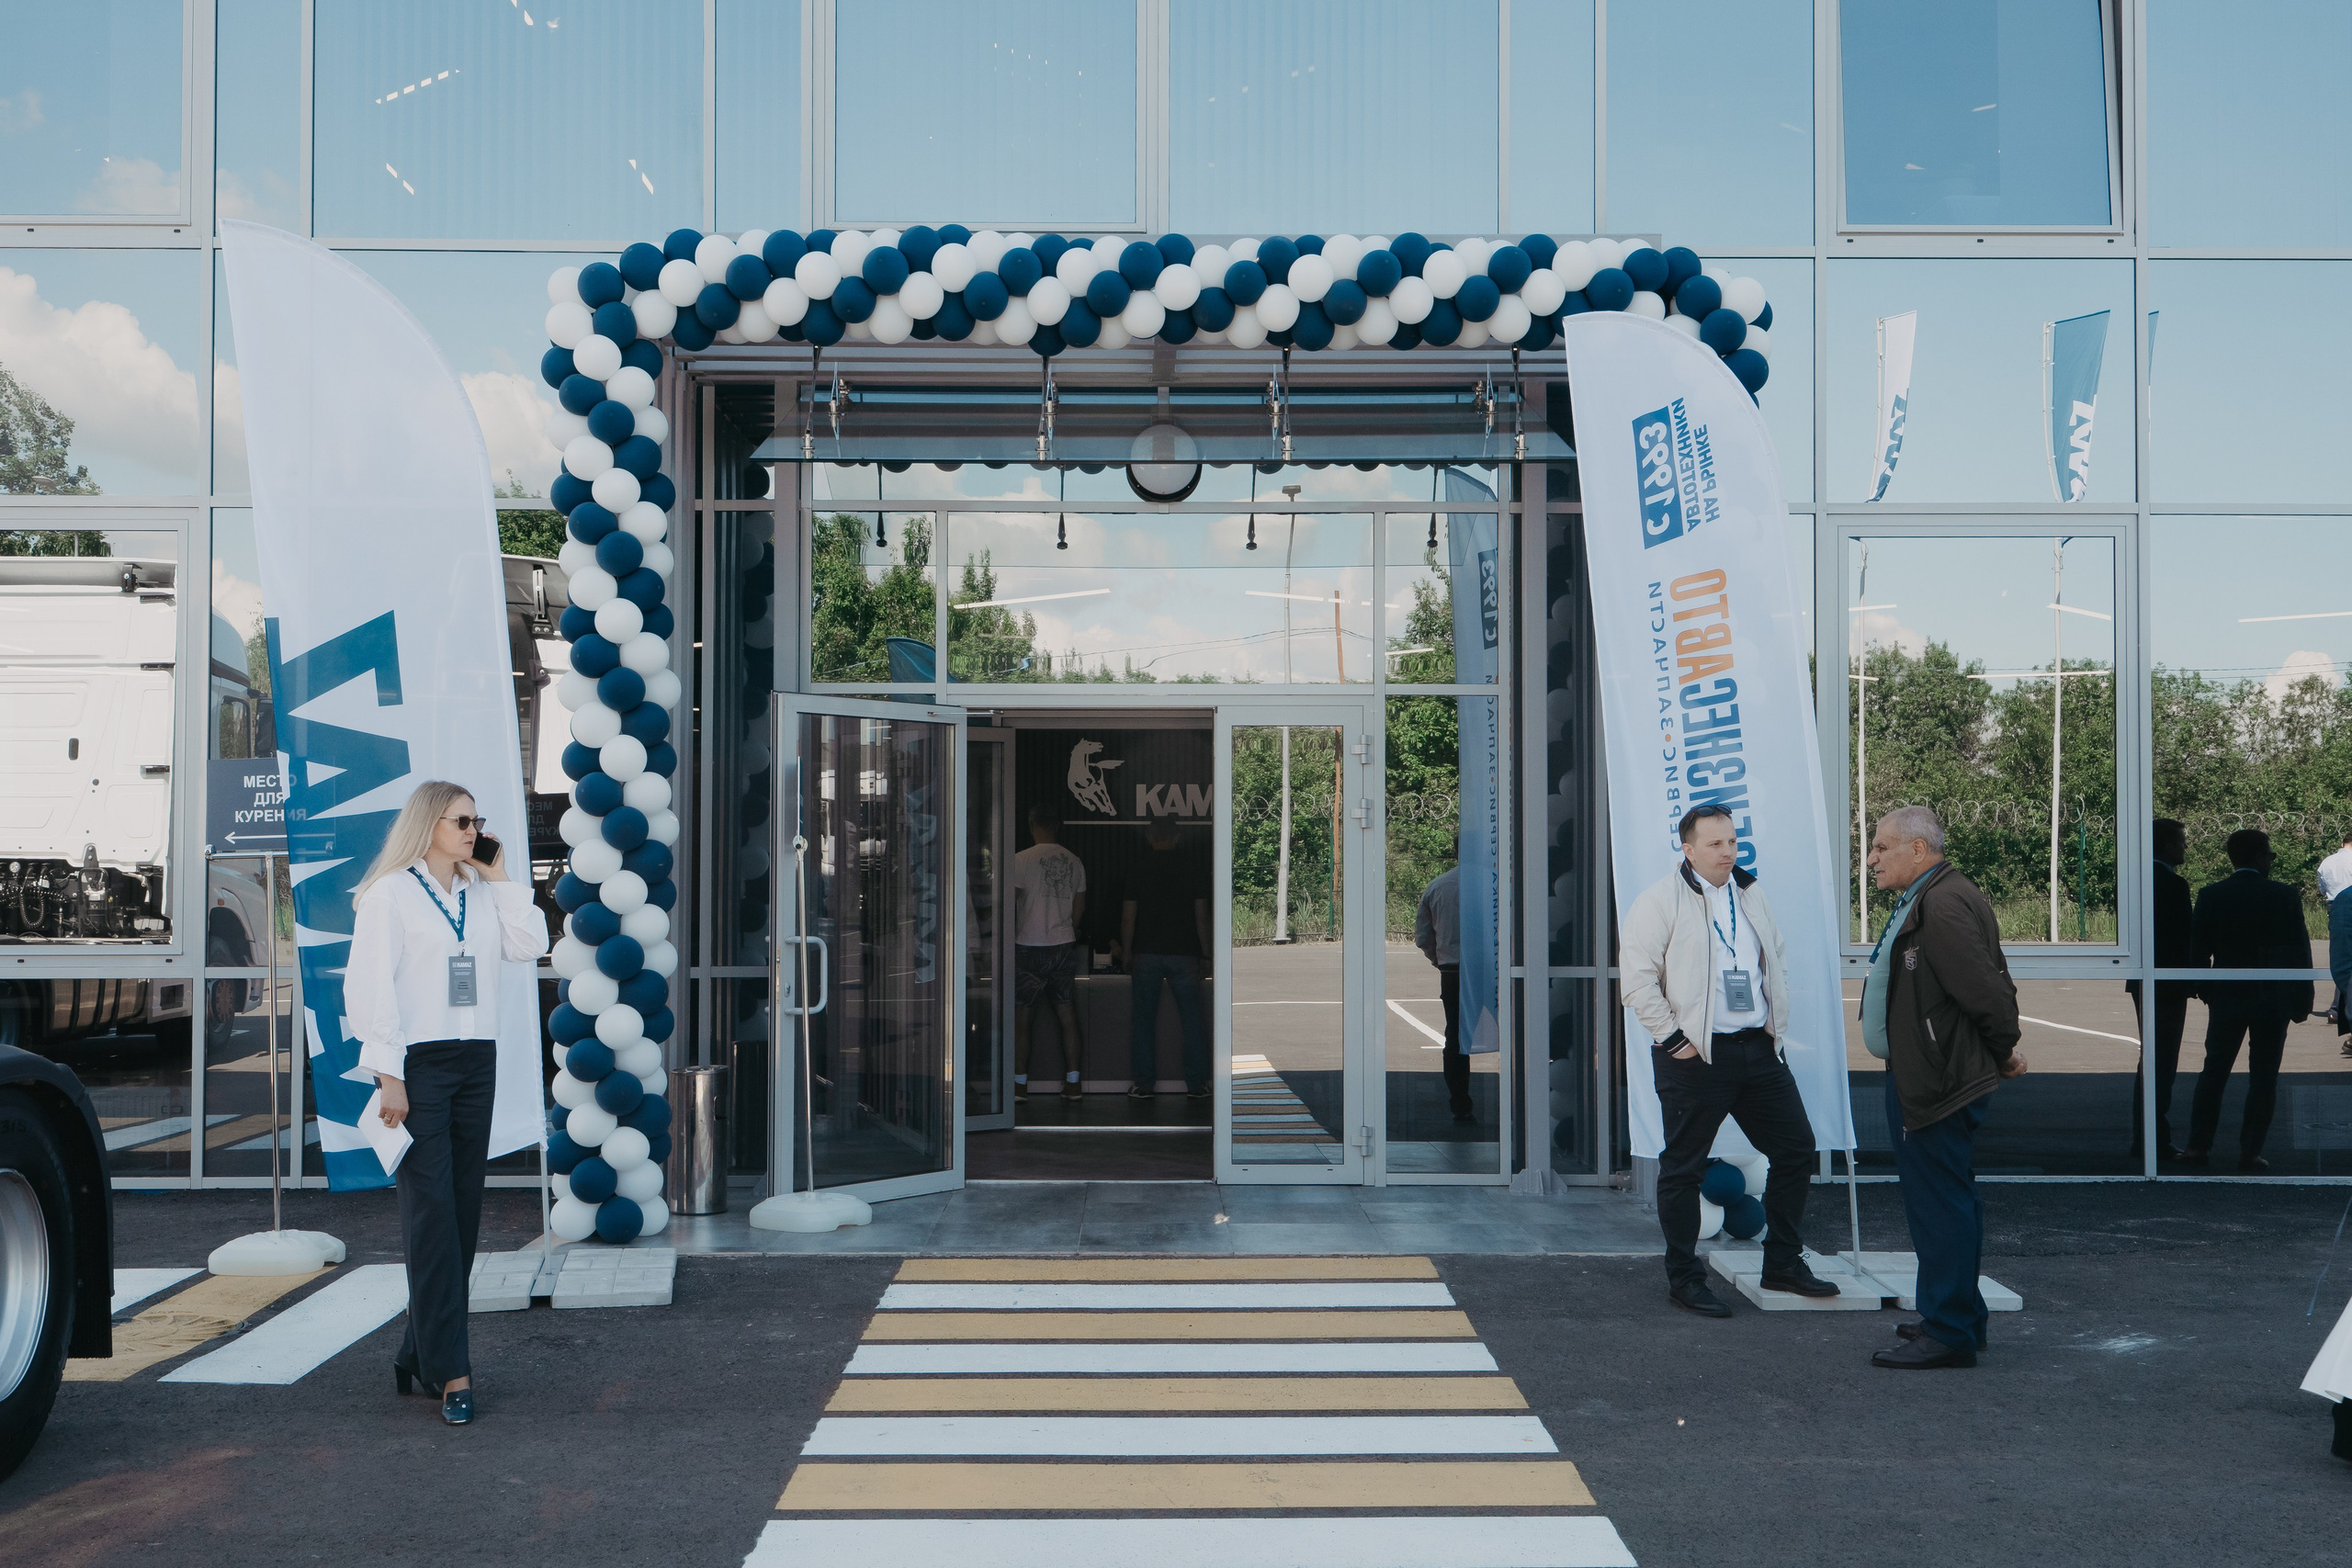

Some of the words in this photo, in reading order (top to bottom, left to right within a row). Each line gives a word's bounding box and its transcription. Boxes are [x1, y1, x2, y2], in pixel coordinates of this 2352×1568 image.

[1865, 388, 1909, 502] MAZ
[2066, 394, 2098, 502] MAZ
[254, 792, 285, 807] ДЛЯ
